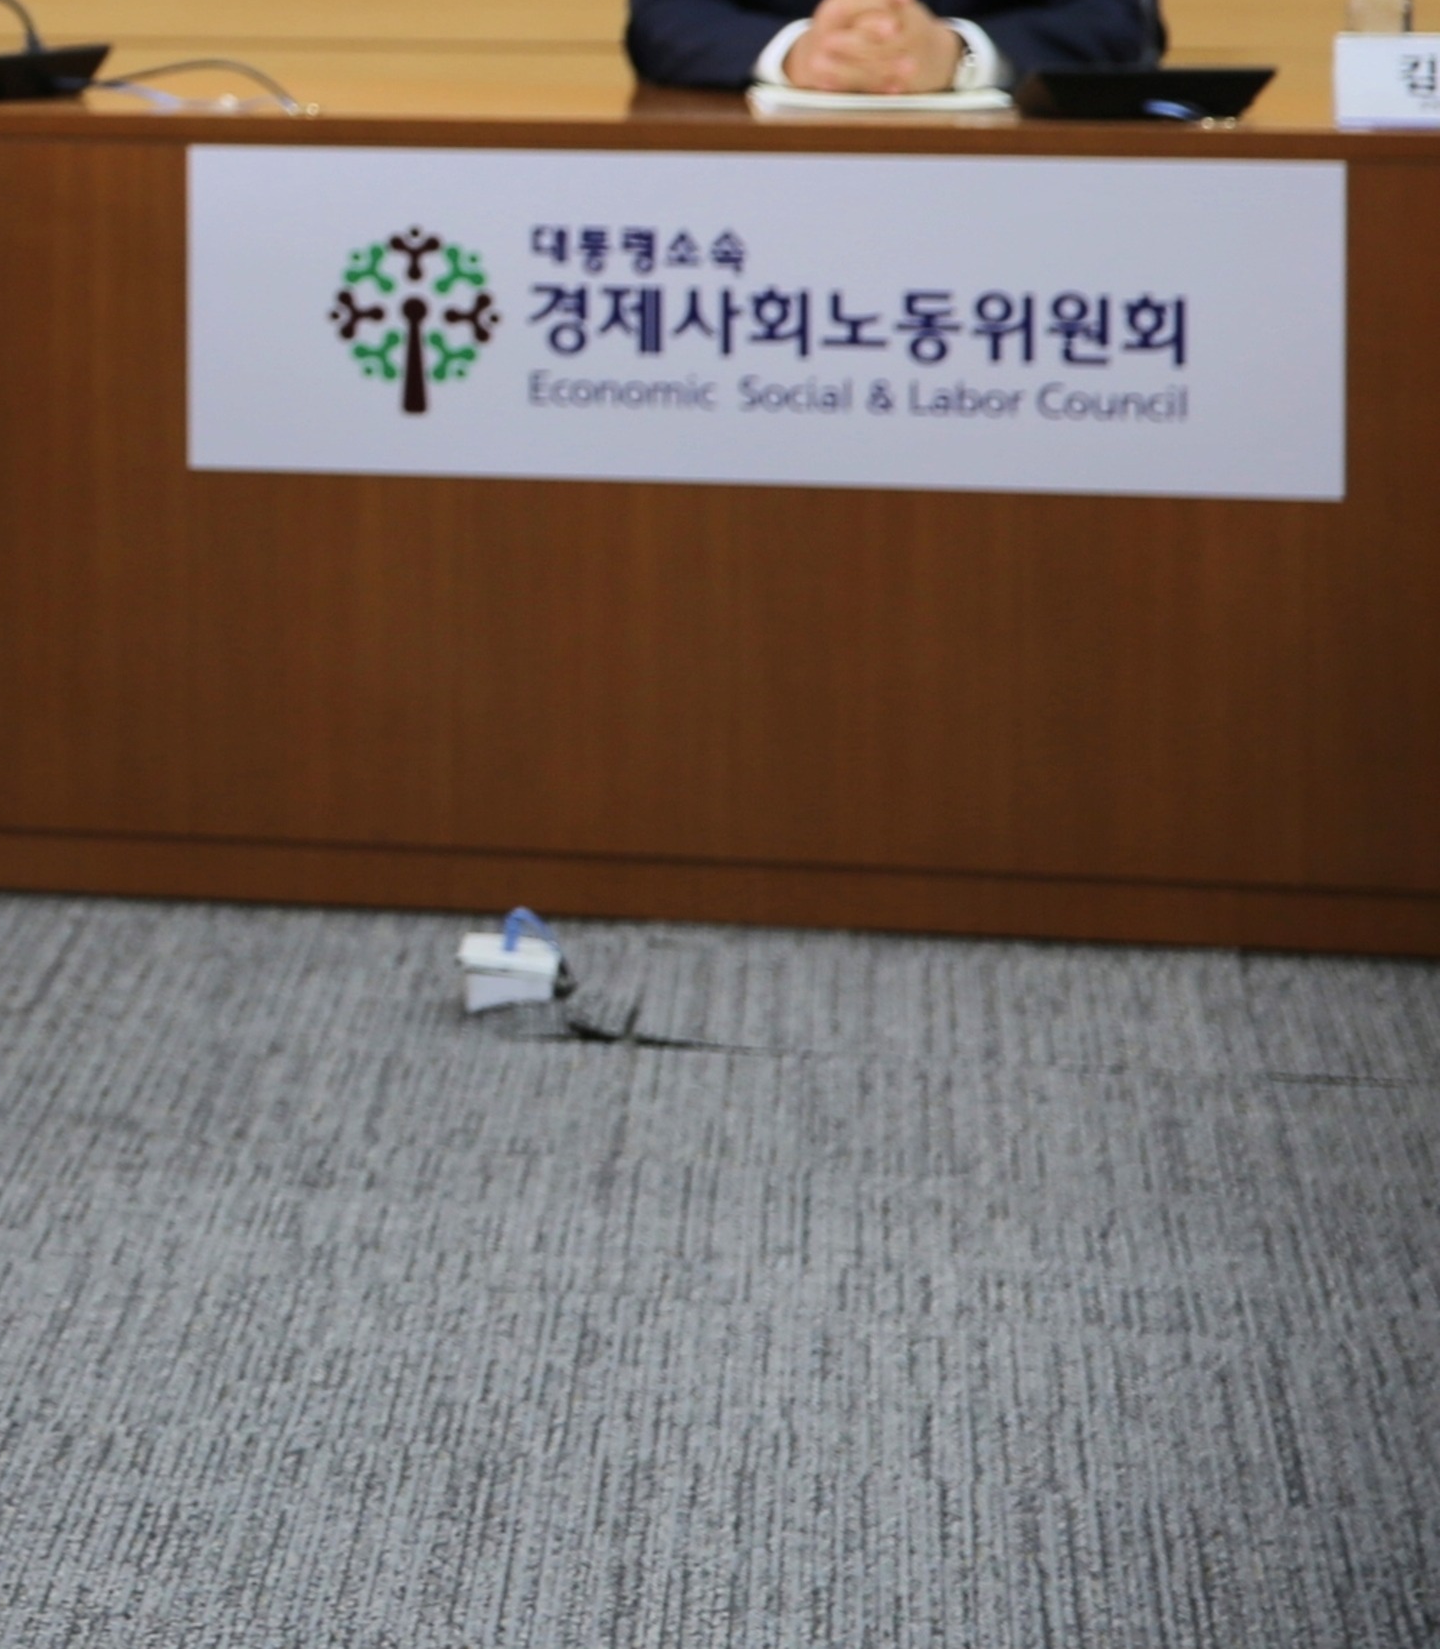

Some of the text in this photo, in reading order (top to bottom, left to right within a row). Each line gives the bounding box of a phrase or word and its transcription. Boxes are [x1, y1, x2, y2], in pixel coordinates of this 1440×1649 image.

[531, 227, 744, 274] 대통령소속
[529, 282, 1188, 366] 경제사회노동위원회
[530, 369, 1188, 424] Economic Social & Labor Council
